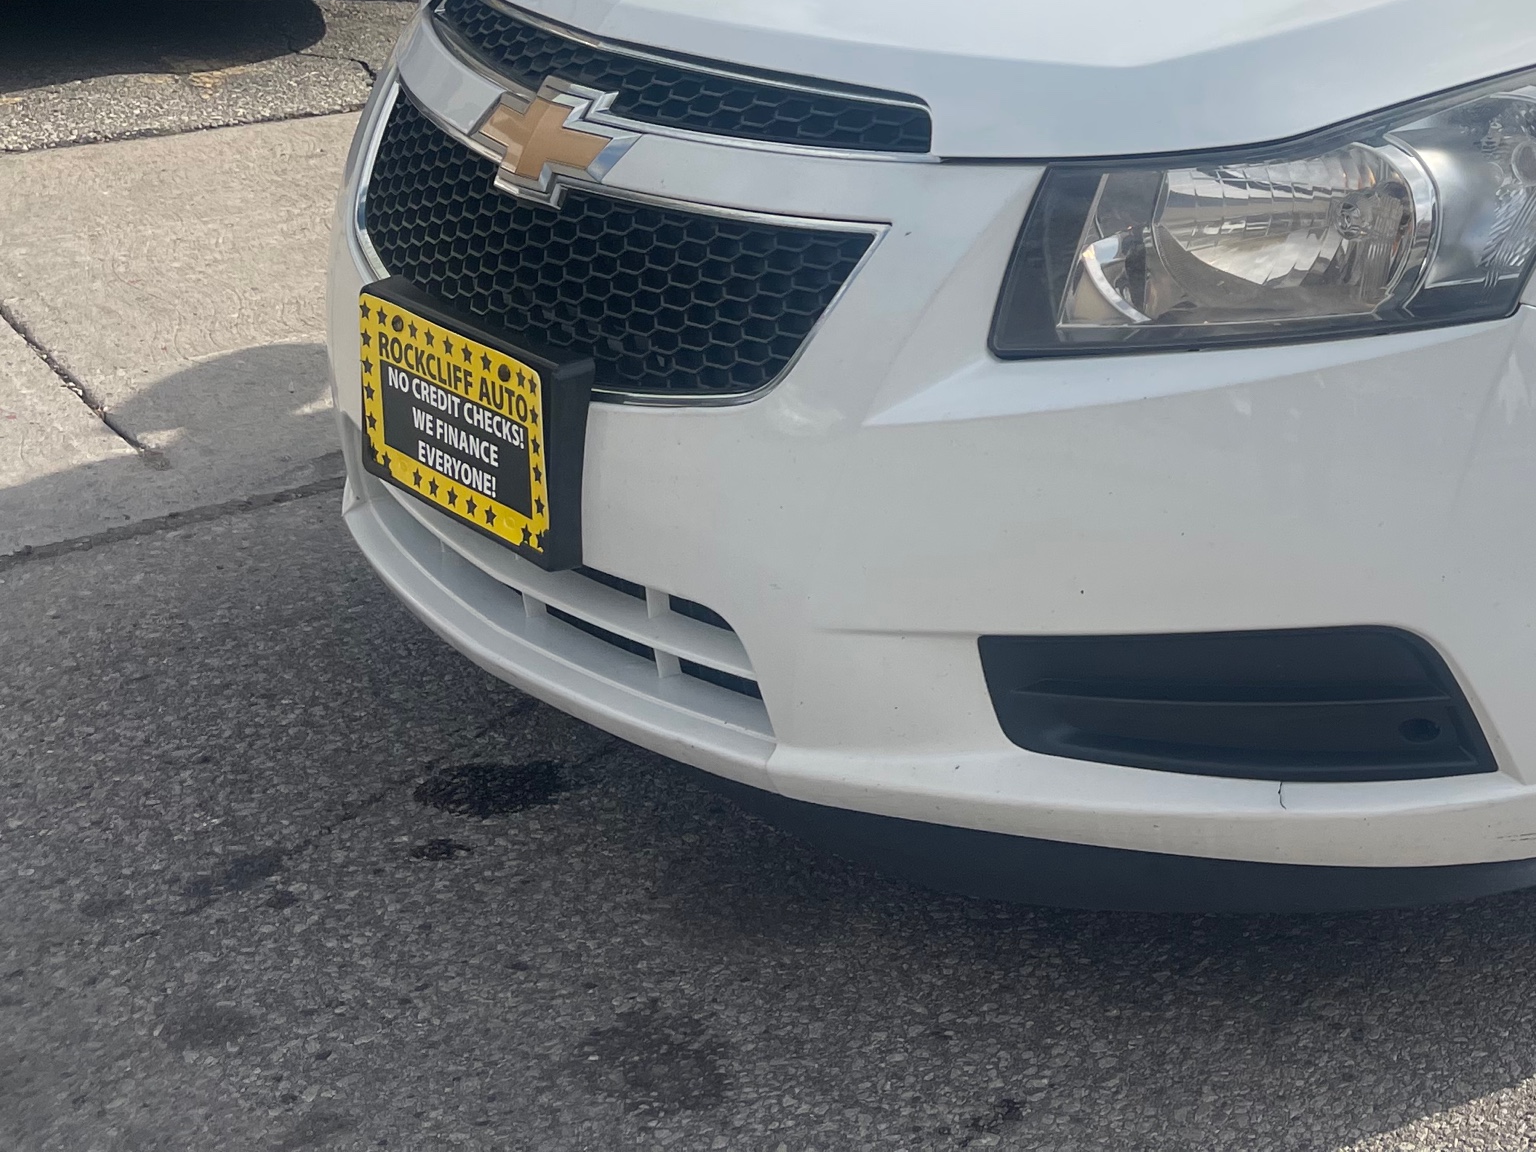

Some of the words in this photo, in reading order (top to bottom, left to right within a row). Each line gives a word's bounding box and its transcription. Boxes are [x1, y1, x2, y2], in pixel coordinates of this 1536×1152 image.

[378, 331, 473, 396] ROCKCLIFF
[479, 376, 528, 423] AUTO
[388, 366, 409, 393] NO
[412, 378, 460, 418] CREDIT
[464, 402, 525, 449] CHECKS!
[412, 406, 433, 436] WE
[436, 418, 499, 467] FINANCE
[418, 439, 497, 498] EVERYONE!
